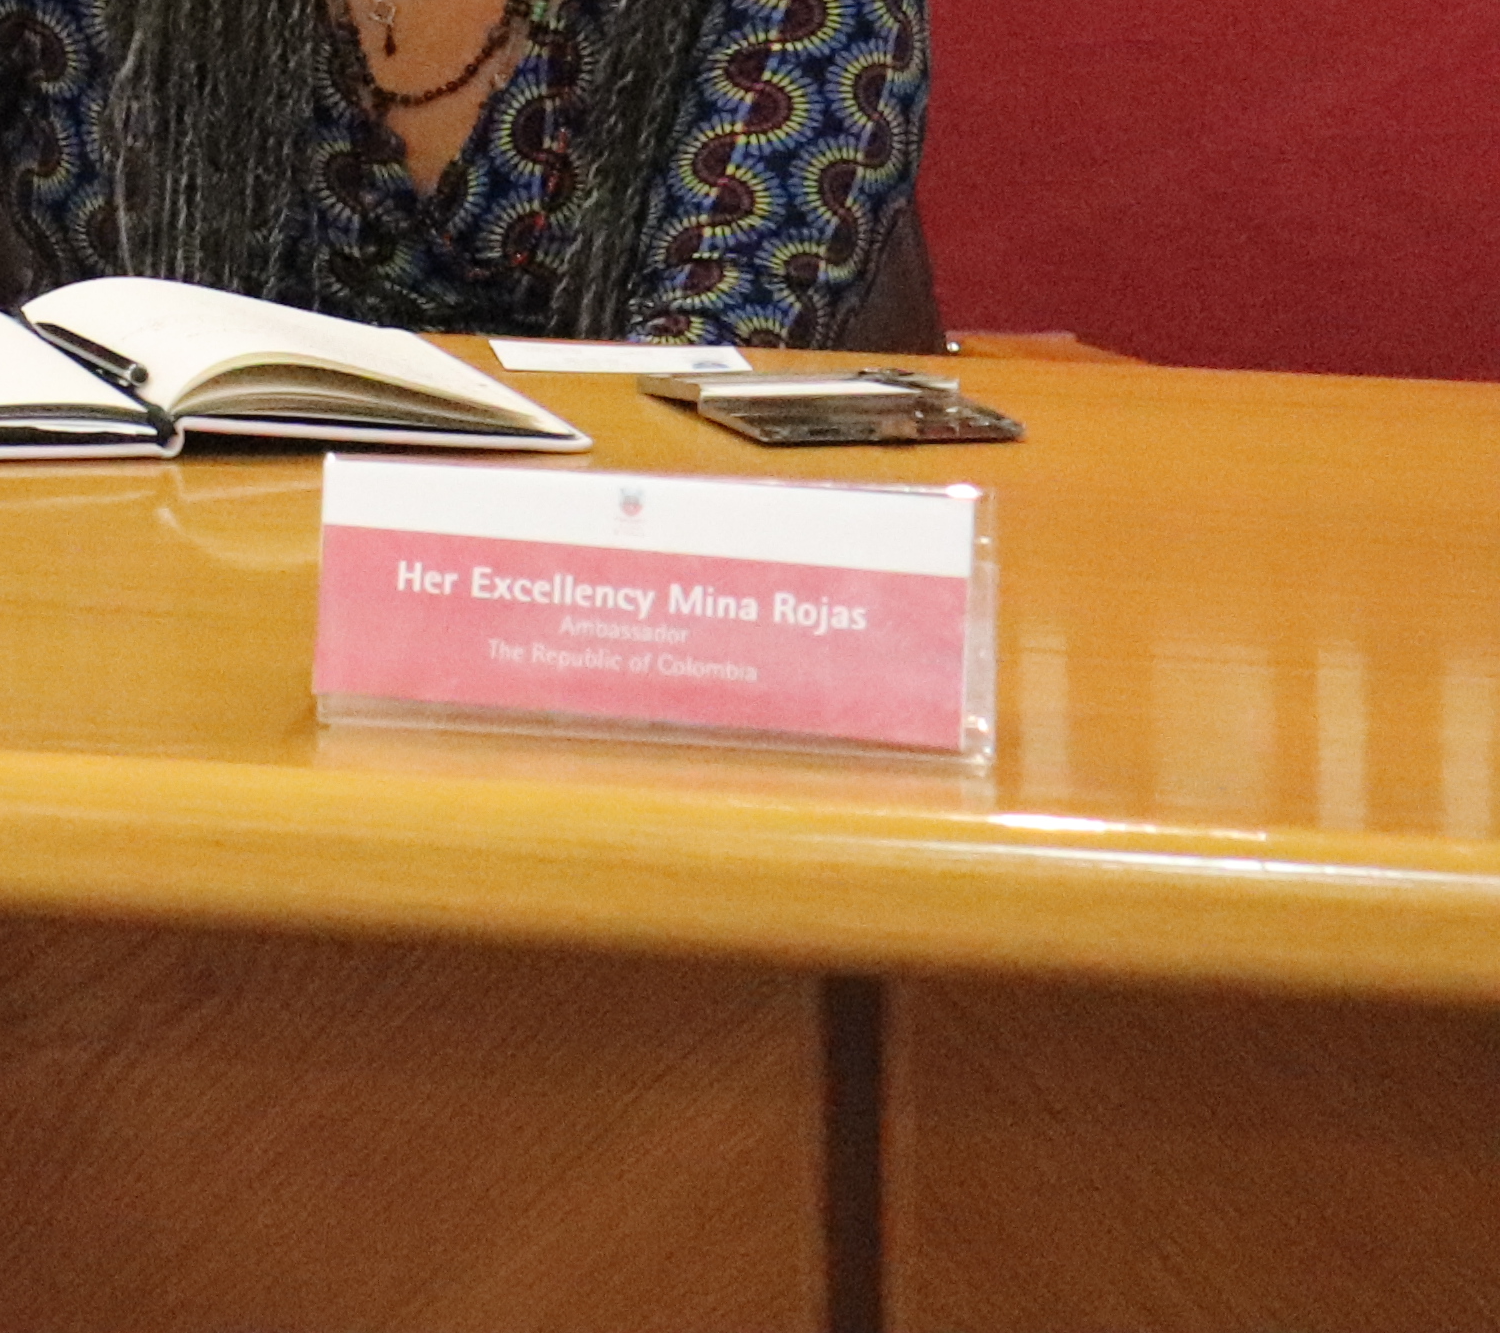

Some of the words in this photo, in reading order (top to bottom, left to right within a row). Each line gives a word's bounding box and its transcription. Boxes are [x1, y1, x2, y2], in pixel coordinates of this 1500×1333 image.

[395, 559, 460, 597] Her
[470, 565, 657, 619] Excellency
[667, 583, 759, 623] Mina
[773, 591, 868, 633] Rojas
[557, 614, 690, 644] Ambassador
[487, 636, 525, 661] The
[530, 642, 622, 675] Republic
[627, 651, 652, 673] of
[655, 655, 759, 685] Colombia
